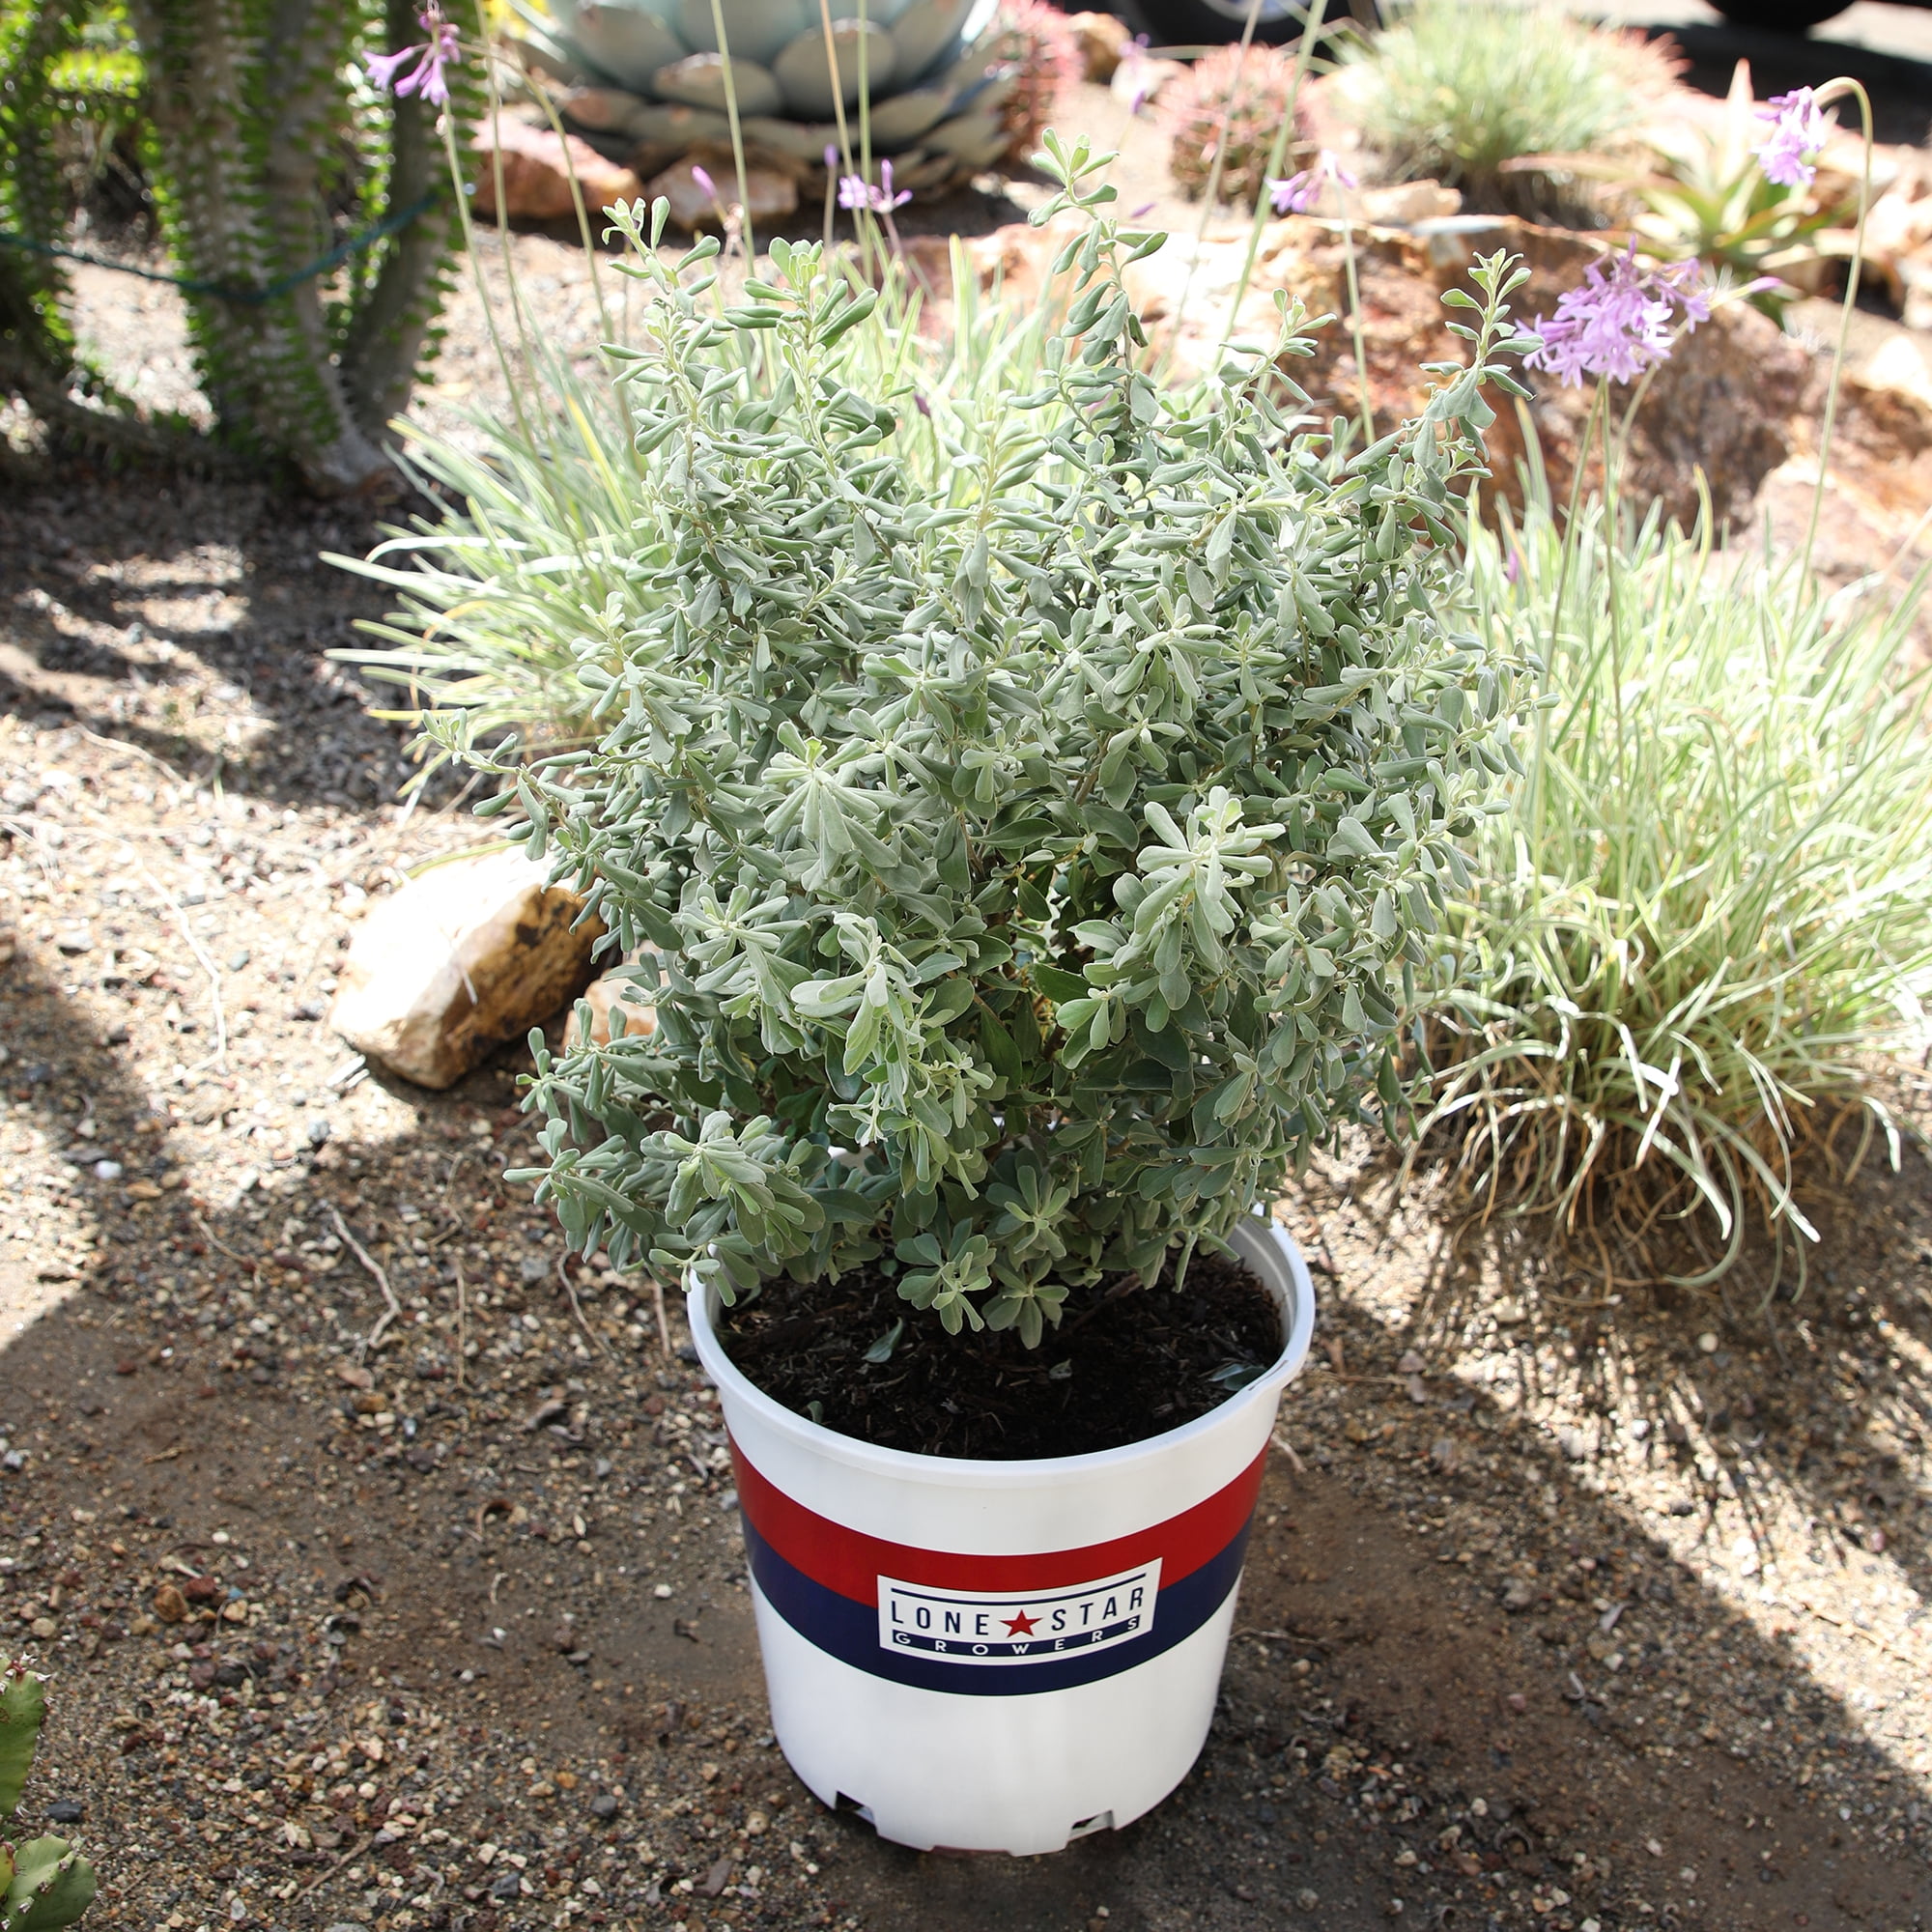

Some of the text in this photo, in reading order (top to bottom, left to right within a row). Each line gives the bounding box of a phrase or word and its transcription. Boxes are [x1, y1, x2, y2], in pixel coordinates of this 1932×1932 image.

[891, 1586, 1144, 1635] LONE STAR
[895, 1616, 1138, 1656] GROWERS
